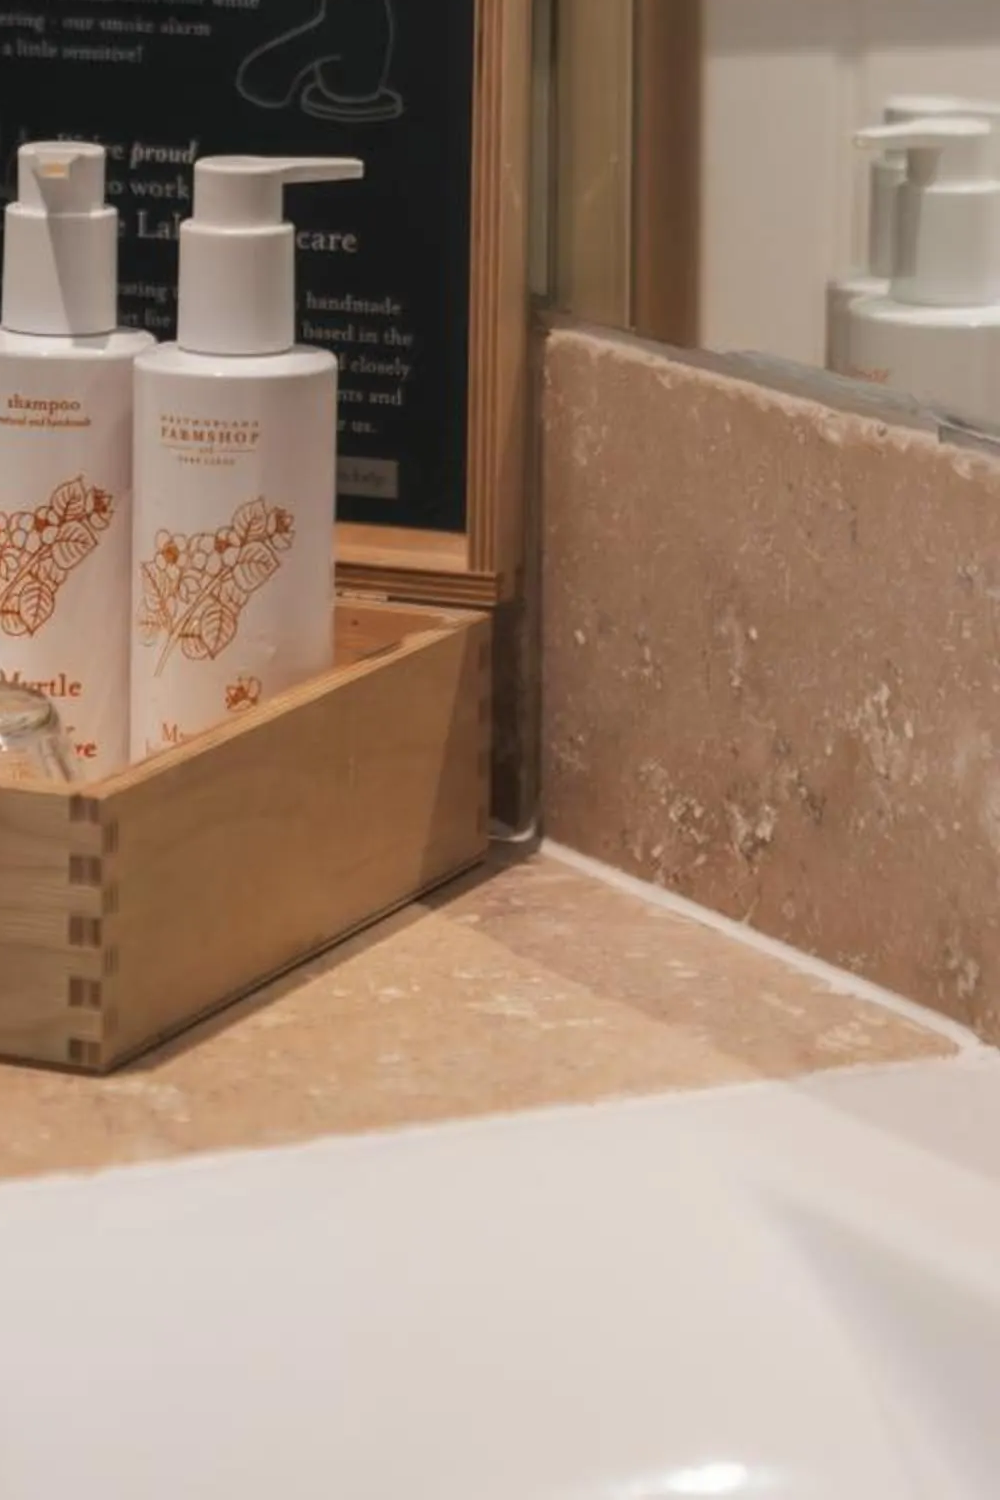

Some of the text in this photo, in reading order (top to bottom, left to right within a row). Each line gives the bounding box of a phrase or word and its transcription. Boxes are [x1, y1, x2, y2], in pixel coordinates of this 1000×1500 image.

[61, 16, 95, 32] our
[98, 14, 155, 35] smoke
[159, 15, 212, 38] alarm
[15, 36, 59, 60] little
[61, 42, 144, 65] sensitive!
[129, 138, 200, 170] proud
[105, 173, 190, 201] o work
[305, 290, 401, 317] handmade
[301, 320, 355, 343] based
[359, 328, 379, 346] in
[383, 326, 413, 348] the
[350, 355, 411, 383] closely
[7, 392, 81, 415] shampoo
[369, 385, 403, 408] and
[160, 426, 261, 446] FARMSHOP
[0, 669, 82, 698] Mrtle
